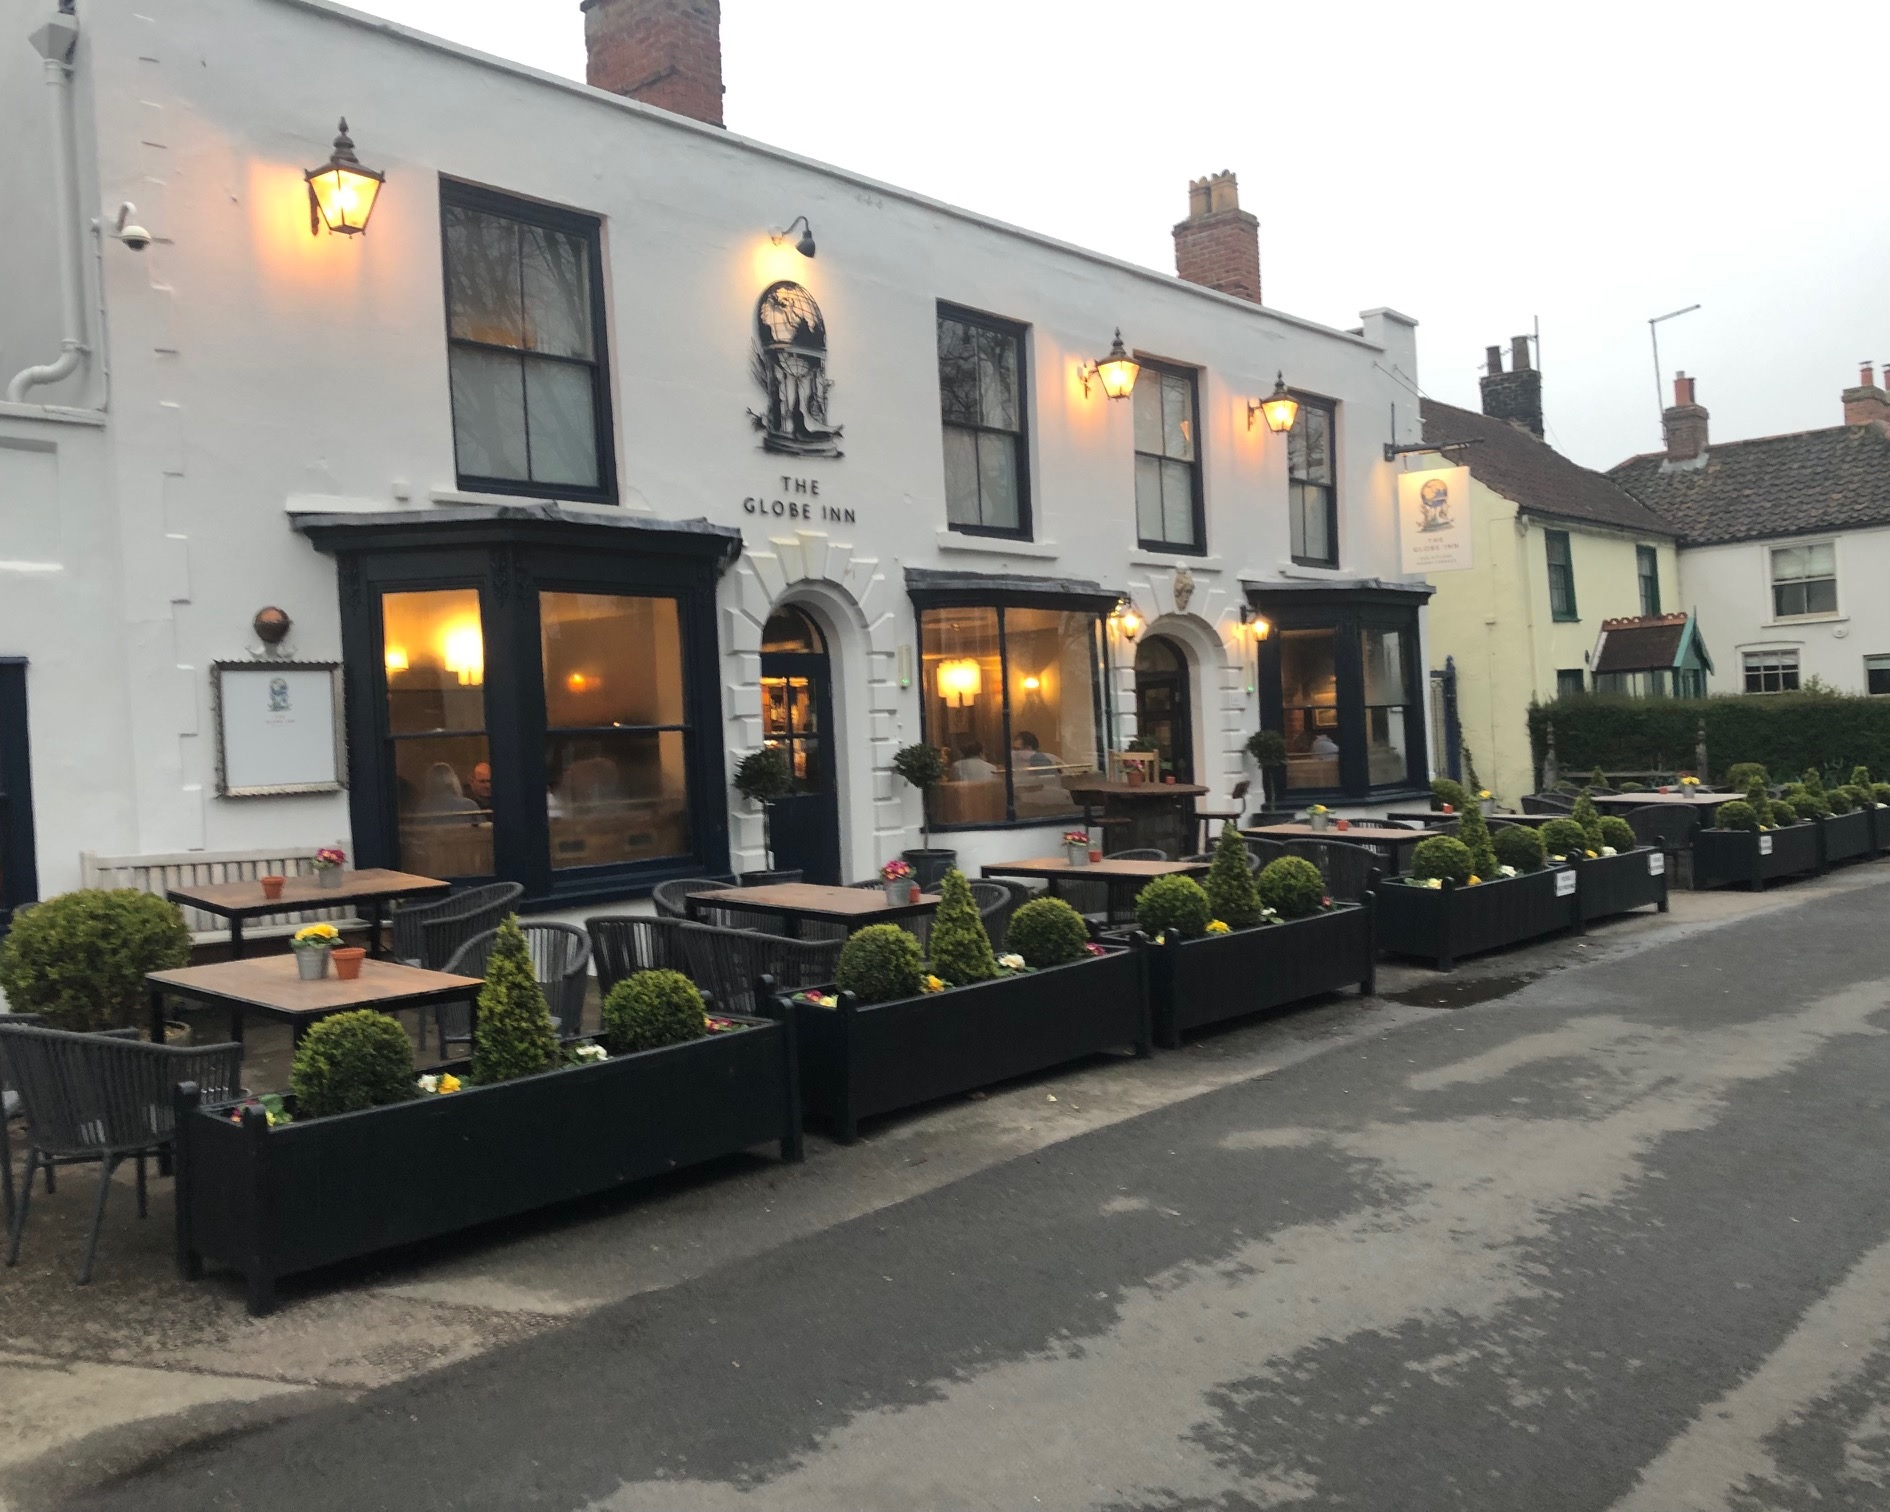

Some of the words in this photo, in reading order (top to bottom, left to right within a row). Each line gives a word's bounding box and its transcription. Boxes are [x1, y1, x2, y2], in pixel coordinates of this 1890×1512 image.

[781, 475, 820, 496] THE
[743, 497, 811, 520] GLOBE
[822, 505, 856, 523] INN
